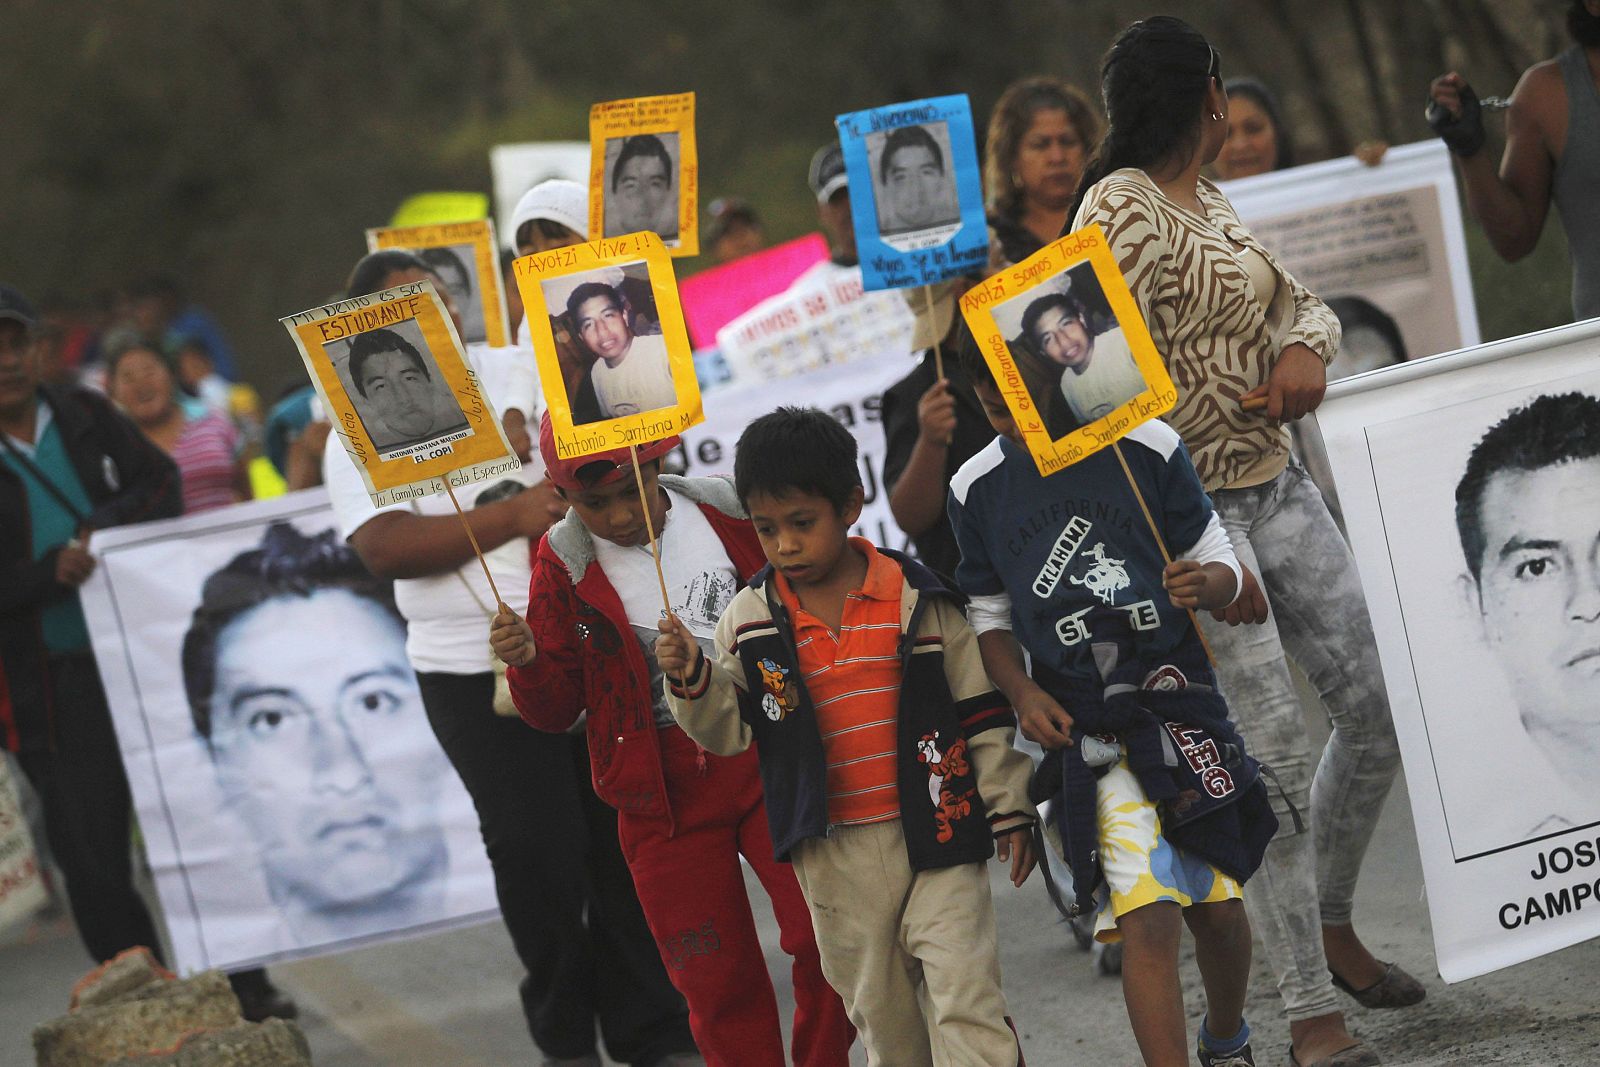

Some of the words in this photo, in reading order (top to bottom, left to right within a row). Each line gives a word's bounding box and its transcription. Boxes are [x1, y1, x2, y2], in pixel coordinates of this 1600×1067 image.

[379, 291, 396, 301] es
[964, 278, 1006, 314] Ayotzi
[1051, 233, 1099, 260] Todos
[317, 297, 422, 342] ESTUDIANTE
[389, 448, 414, 459] ANTONIO
[414, 442, 440, 453] SANTANA
[440, 432, 468, 446] MAESTRO
[557, 431, 607, 457] Antonio
[612, 418, 673, 445] Santana
[1039, 443, 1083, 473] Antonio
[1128, 384, 1176, 420] Maestro
[415, 454, 427, 464] EL
[430, 446, 453, 459] COPI
[391, 484, 425, 502] familia
[431, 481, 443, 493] te
[473, 457, 521, 481] Esperando
[1007, 498, 1135, 557] CALIFORNIA
[1034, 517, 1090, 597] OKLAHOMA
[1530, 837, 1600, 880] JOS
